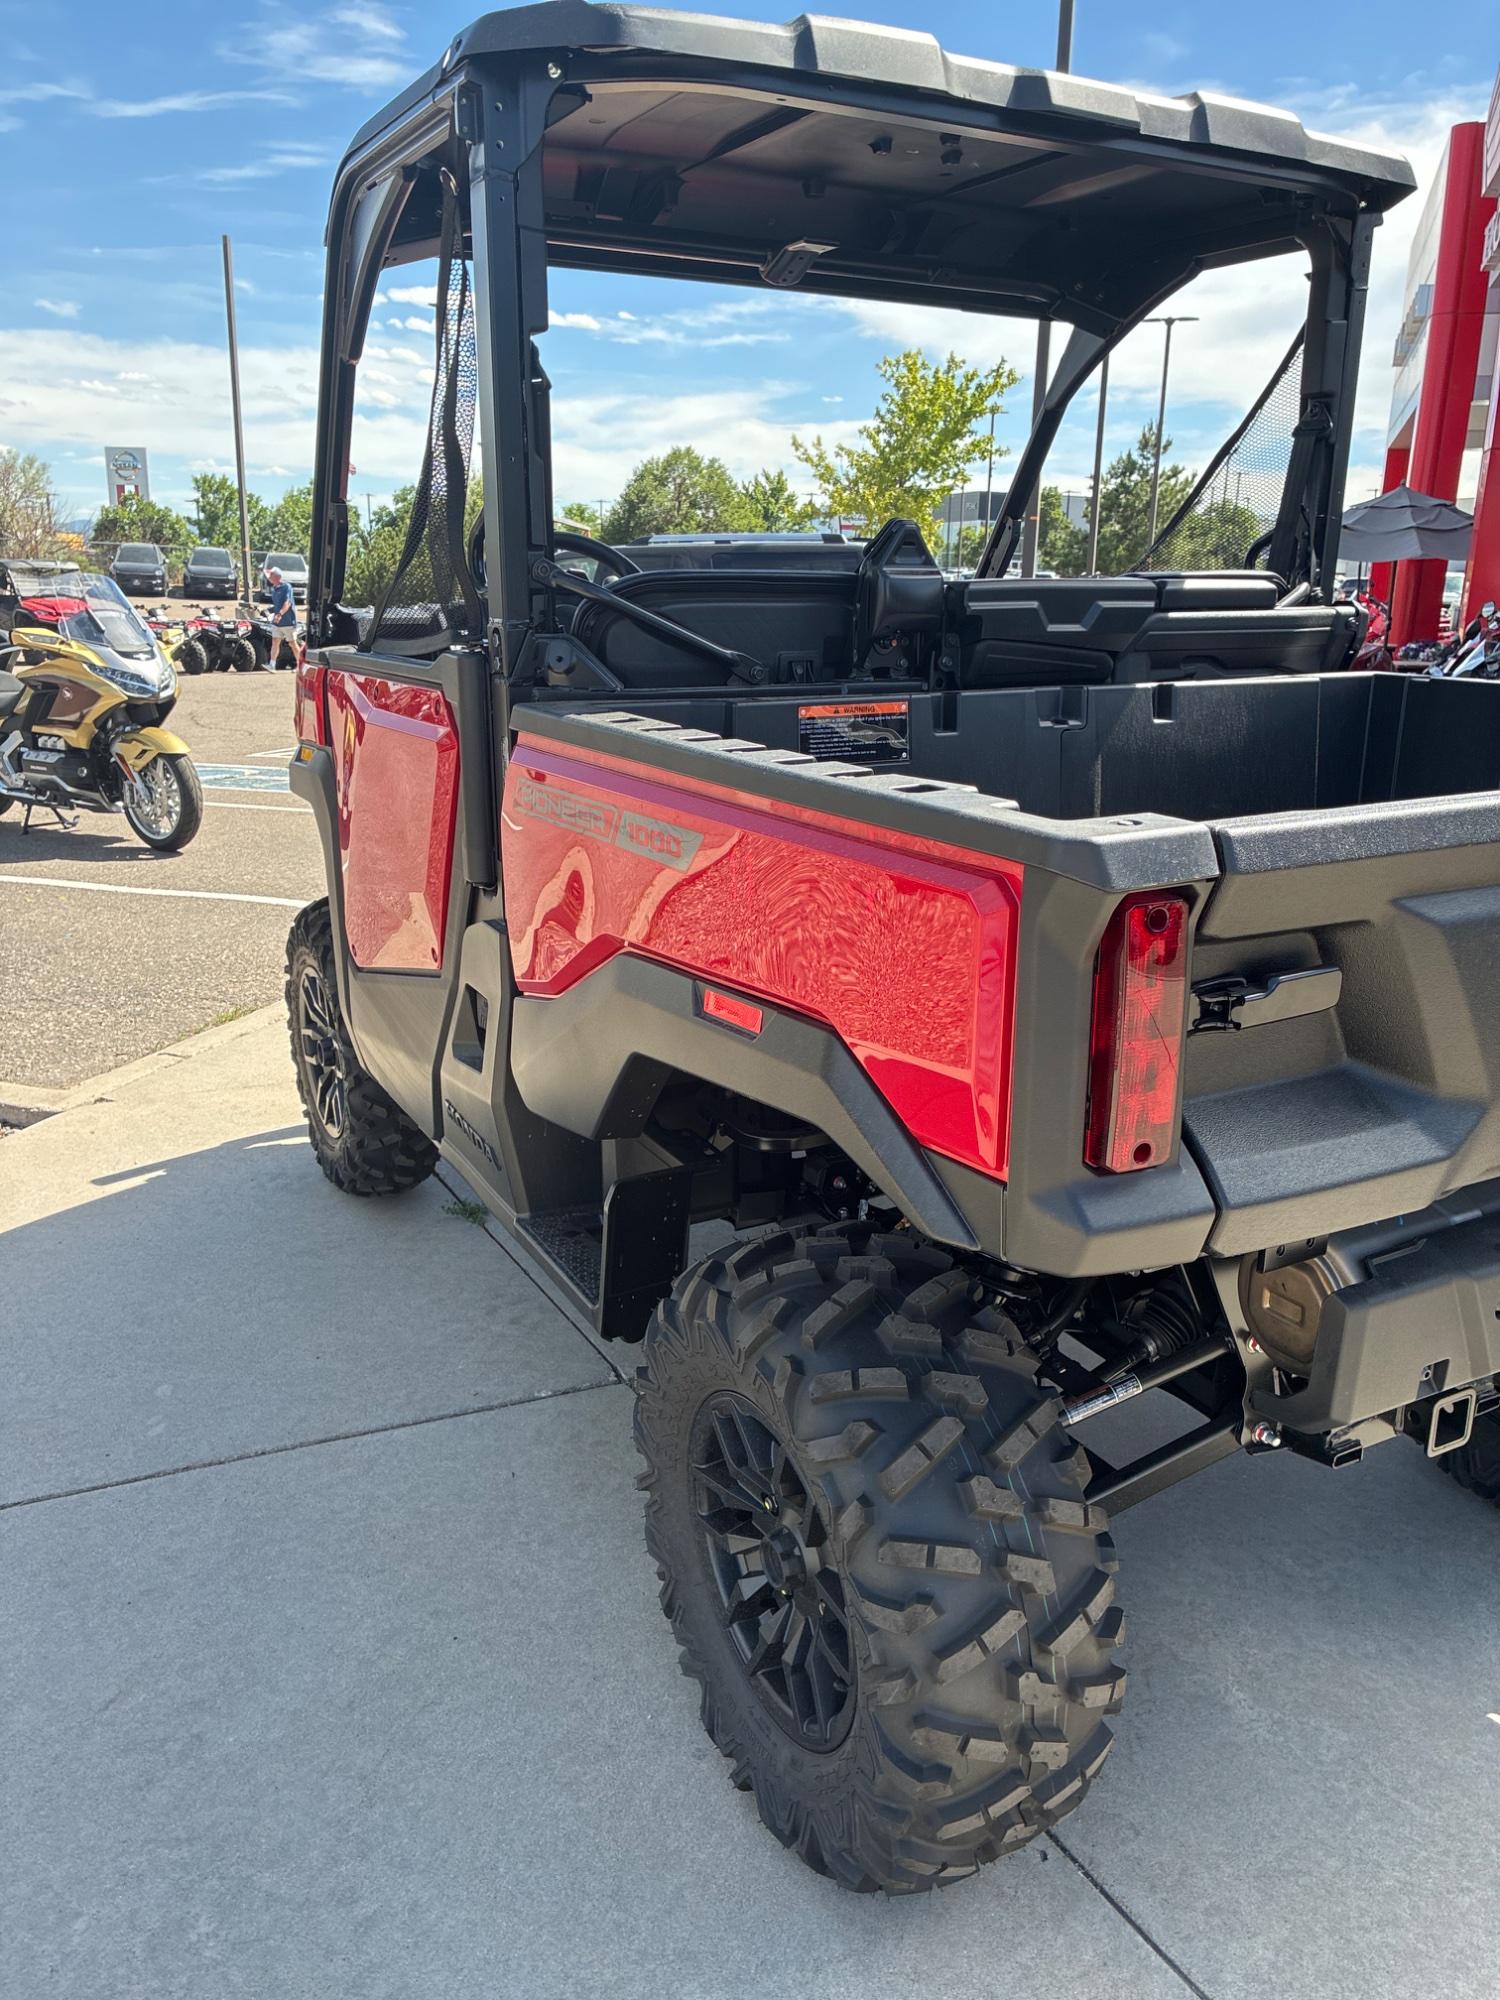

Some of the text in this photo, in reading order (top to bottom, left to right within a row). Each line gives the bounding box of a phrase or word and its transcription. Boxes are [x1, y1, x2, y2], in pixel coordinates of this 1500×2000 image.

[843, 705, 875, 714] WARNING
[517, 785, 682, 858] PIONEER 1000
